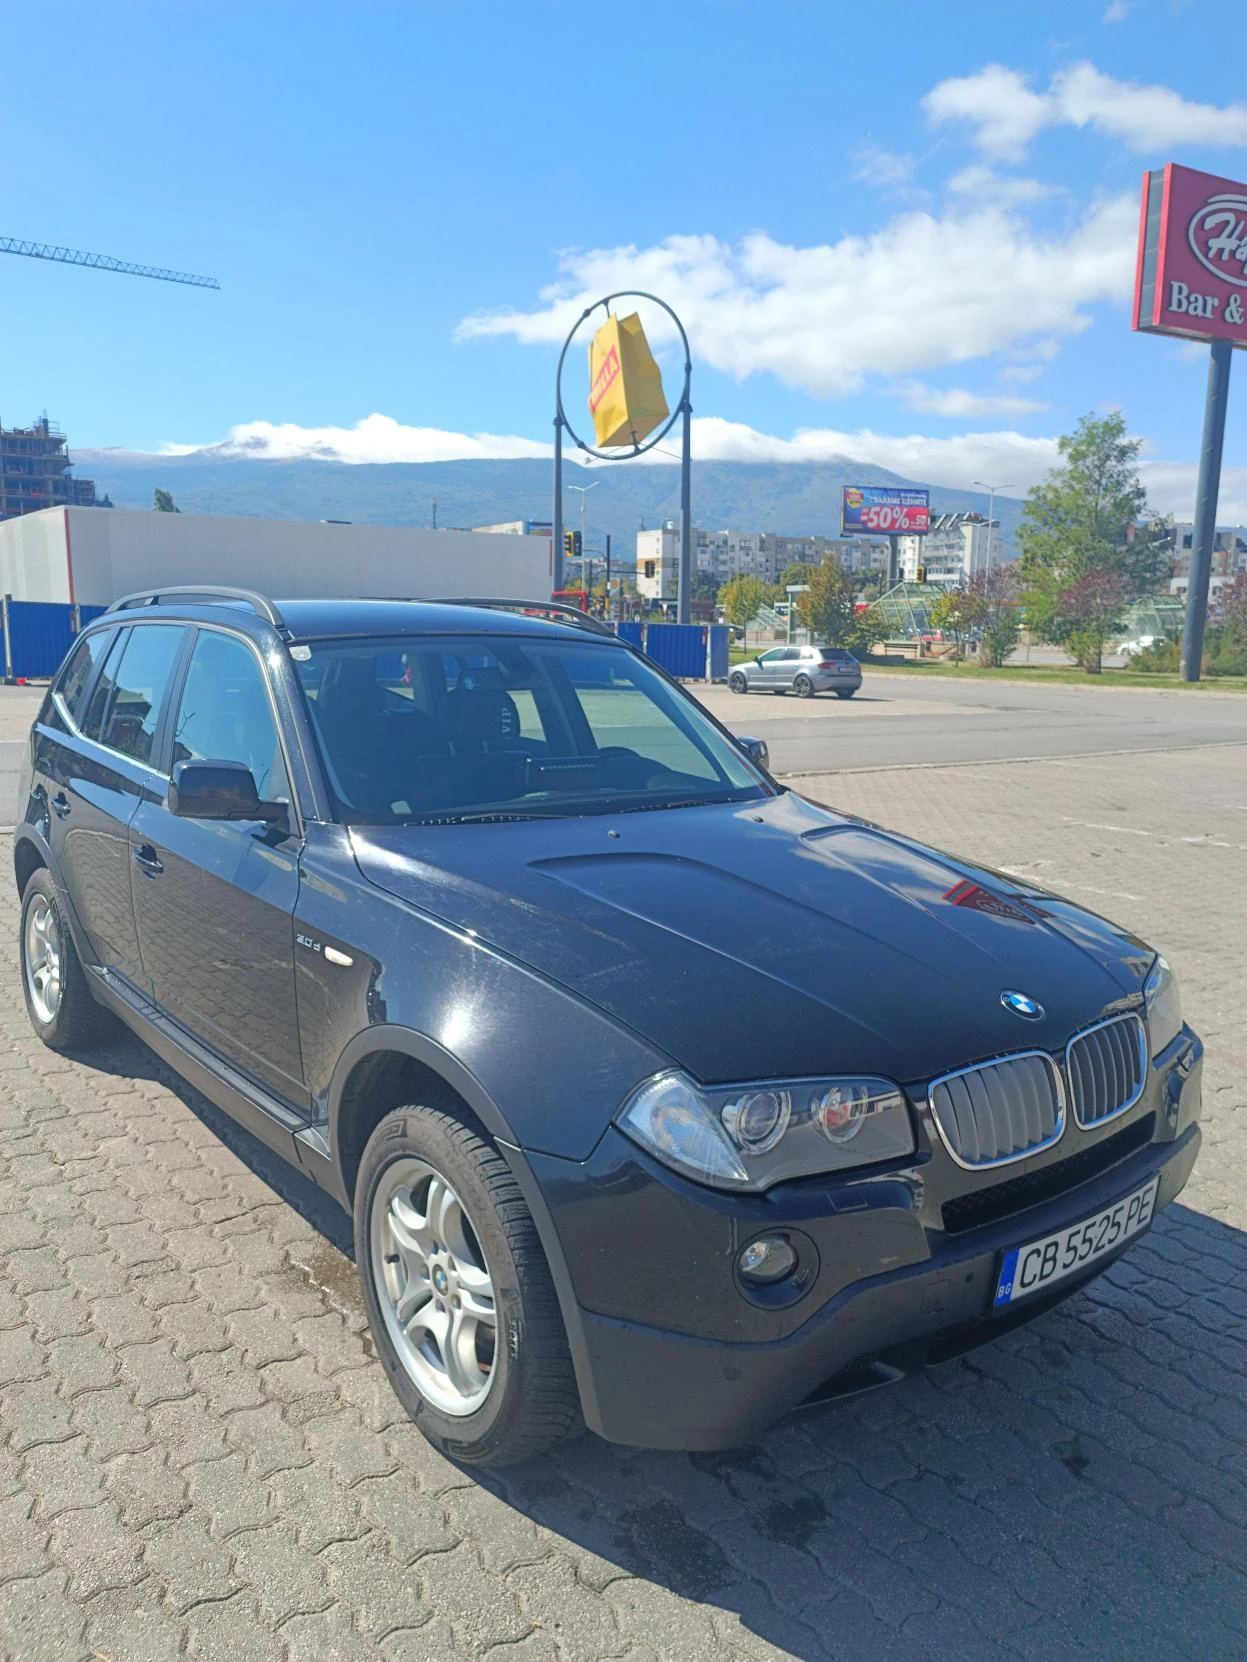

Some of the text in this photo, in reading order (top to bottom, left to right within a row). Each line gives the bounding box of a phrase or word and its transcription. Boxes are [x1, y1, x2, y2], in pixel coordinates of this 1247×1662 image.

[1204, 212, 1247, 274] Ha
[1169, 281, 1245, 325] Bar &
[861, 507, 909, 528] -50%
[997, 1282, 1012, 1298] BG
